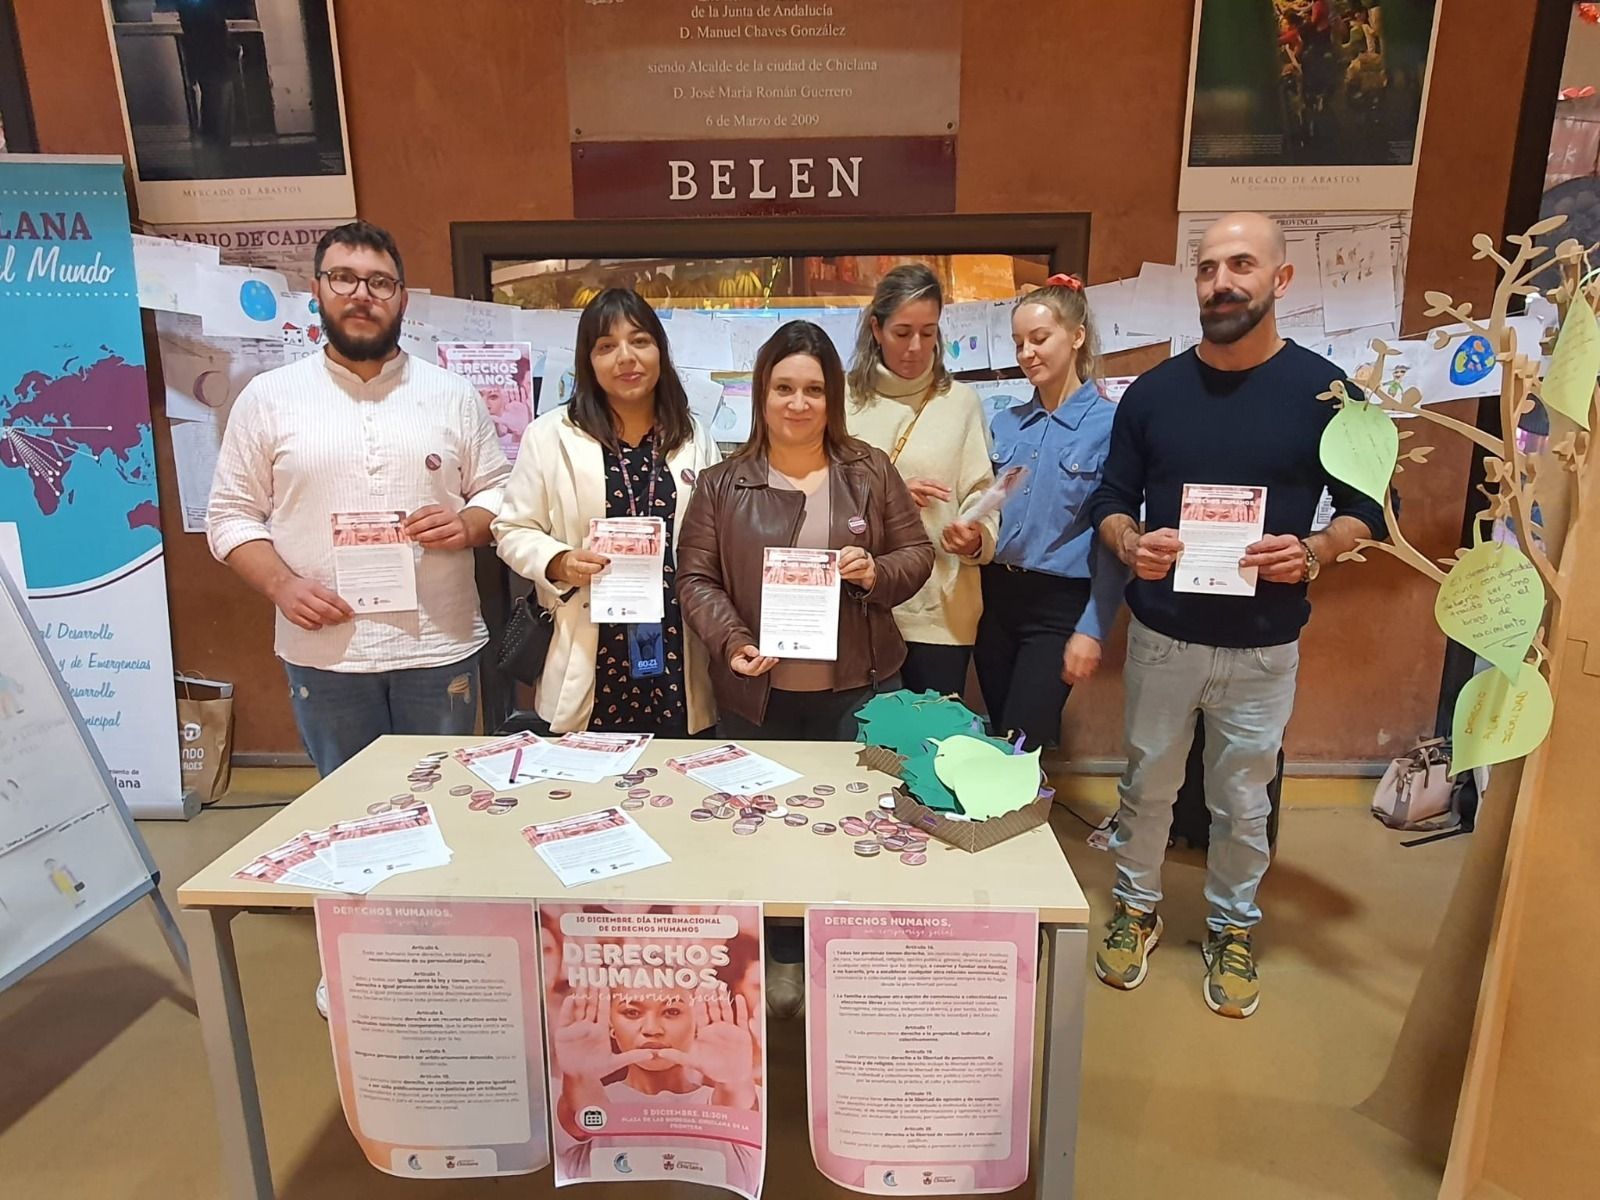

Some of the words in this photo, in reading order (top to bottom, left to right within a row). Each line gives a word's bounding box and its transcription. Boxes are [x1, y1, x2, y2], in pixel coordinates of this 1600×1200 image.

[691, 6, 706, 18] de
[709, 5, 719, 18] la
[722, 5, 752, 18] Junta
[756, 5, 771, 17] de
[774, 4, 833, 17] Andalucía
[680, 27, 693, 39] D.
[698, 26, 741, 39] Manuel
[744, 25, 788, 38] Chaves
[791, 24, 846, 38] González
[648, 61, 686, 74] siendo
[689, 60, 733, 73] Alcalde
[736, 59, 750, 72] de
[753, 59, 764, 72] la
[767, 59, 805, 72] ciudad
[809, 59, 822, 72] de
[826, 58, 877, 71] Chiclana
[673, 87, 687, 100] D.
[690, 86, 716, 99] José
[719, 86, 752, 99] María
[756, 85, 797, 99] Román
[801, 85, 852, 98] Guerrero
[706, 115, 713, 127] 6
[716, 115, 730, 127] de
[733, 114, 771, 127] Marzo
[774, 114, 788, 126] de
[791, 114, 820, 127] 2009
[668, 157, 863, 200] BELEN
[236, 230, 264, 248] DE
[26, 245, 116, 284] Mundo
[58, 622, 114, 640] Desarrollo
[58, 658, 65, 672] y
[70, 656, 82, 669] de
[88, 652, 151, 673] Emergencias
[114, 776, 141, 788] lana
[332, 906, 393, 916] DERECHOS
[825, 916, 887, 926] DERECHOS
[563, 942, 730, 967] DERECHOS
